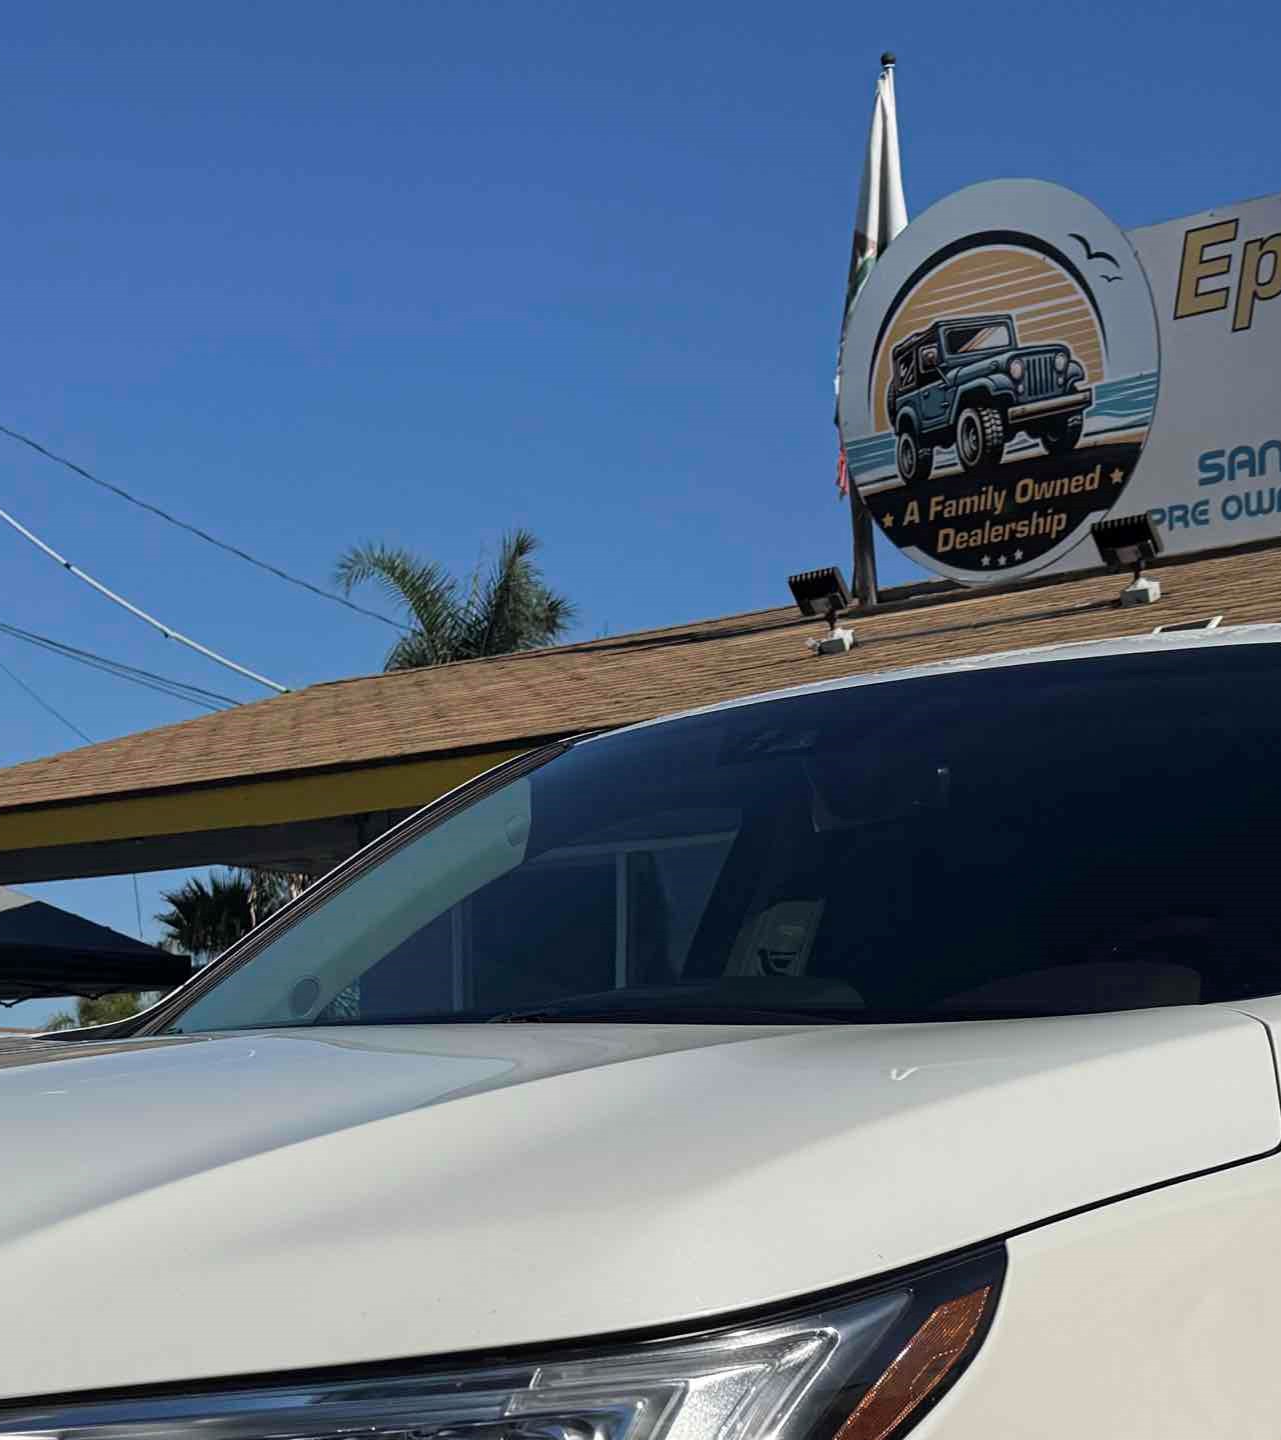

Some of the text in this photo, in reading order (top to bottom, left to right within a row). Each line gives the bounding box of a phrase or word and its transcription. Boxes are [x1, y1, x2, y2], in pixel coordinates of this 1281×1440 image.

[903, 464, 1102, 527] A Family Owned
[1151, 500, 1210, 530] PRE
[936, 508, 1067, 553] Dealership
